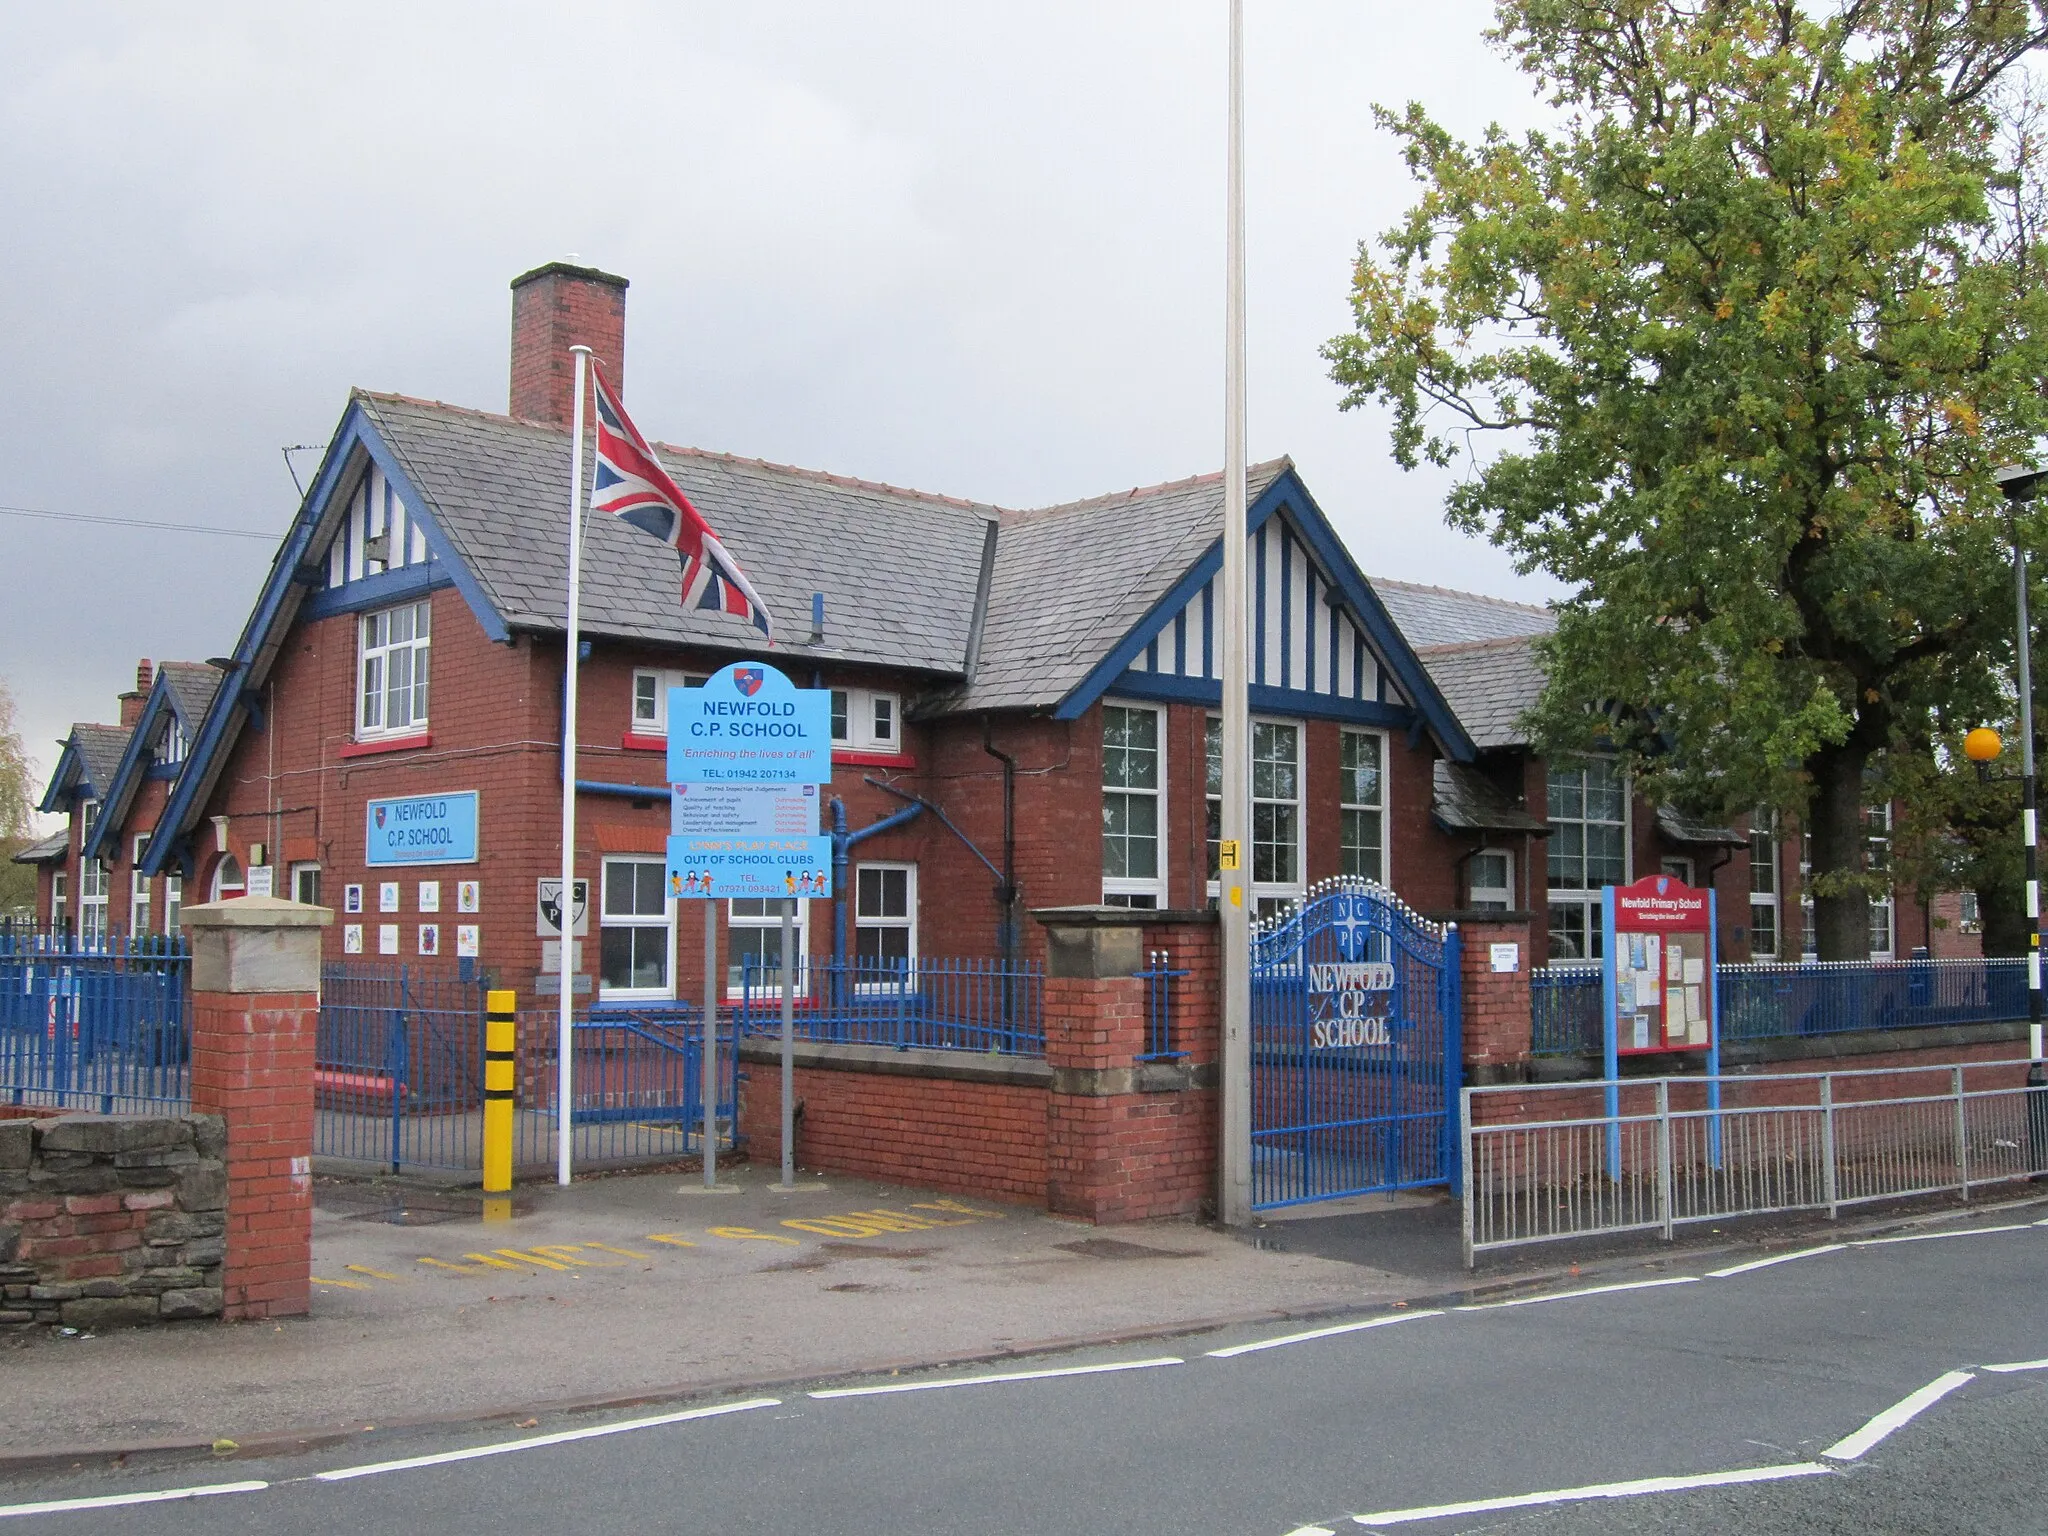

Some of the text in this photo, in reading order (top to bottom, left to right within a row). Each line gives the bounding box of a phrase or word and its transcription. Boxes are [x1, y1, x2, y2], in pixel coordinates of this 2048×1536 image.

[703, 701, 795, 716] NEWFOLD
[691, 722, 808, 738] C.P. SCHOOL
[739, 749, 757, 759] the
[759, 749, 783, 759] lives
[786, 749, 797, 759] of
[702, 769, 796, 779] TEL: 01942 207134
[395, 801, 447, 821] NEWFOLD
[388, 827, 453, 847] C.P. SCHOOL
[684, 855, 814, 864] OUT OF SCHOOL CLUBS
[544, 886, 554, 898] N
[1339, 902, 1363, 917] N C
[1622, 897, 1702, 911] Newfold Primary School
[549, 908, 558, 920] P
[1341, 931, 1363, 946] P S
[1308, 963, 1395, 993] NEWFOLD
[1314, 1018, 1391, 1048] SCHOOL
